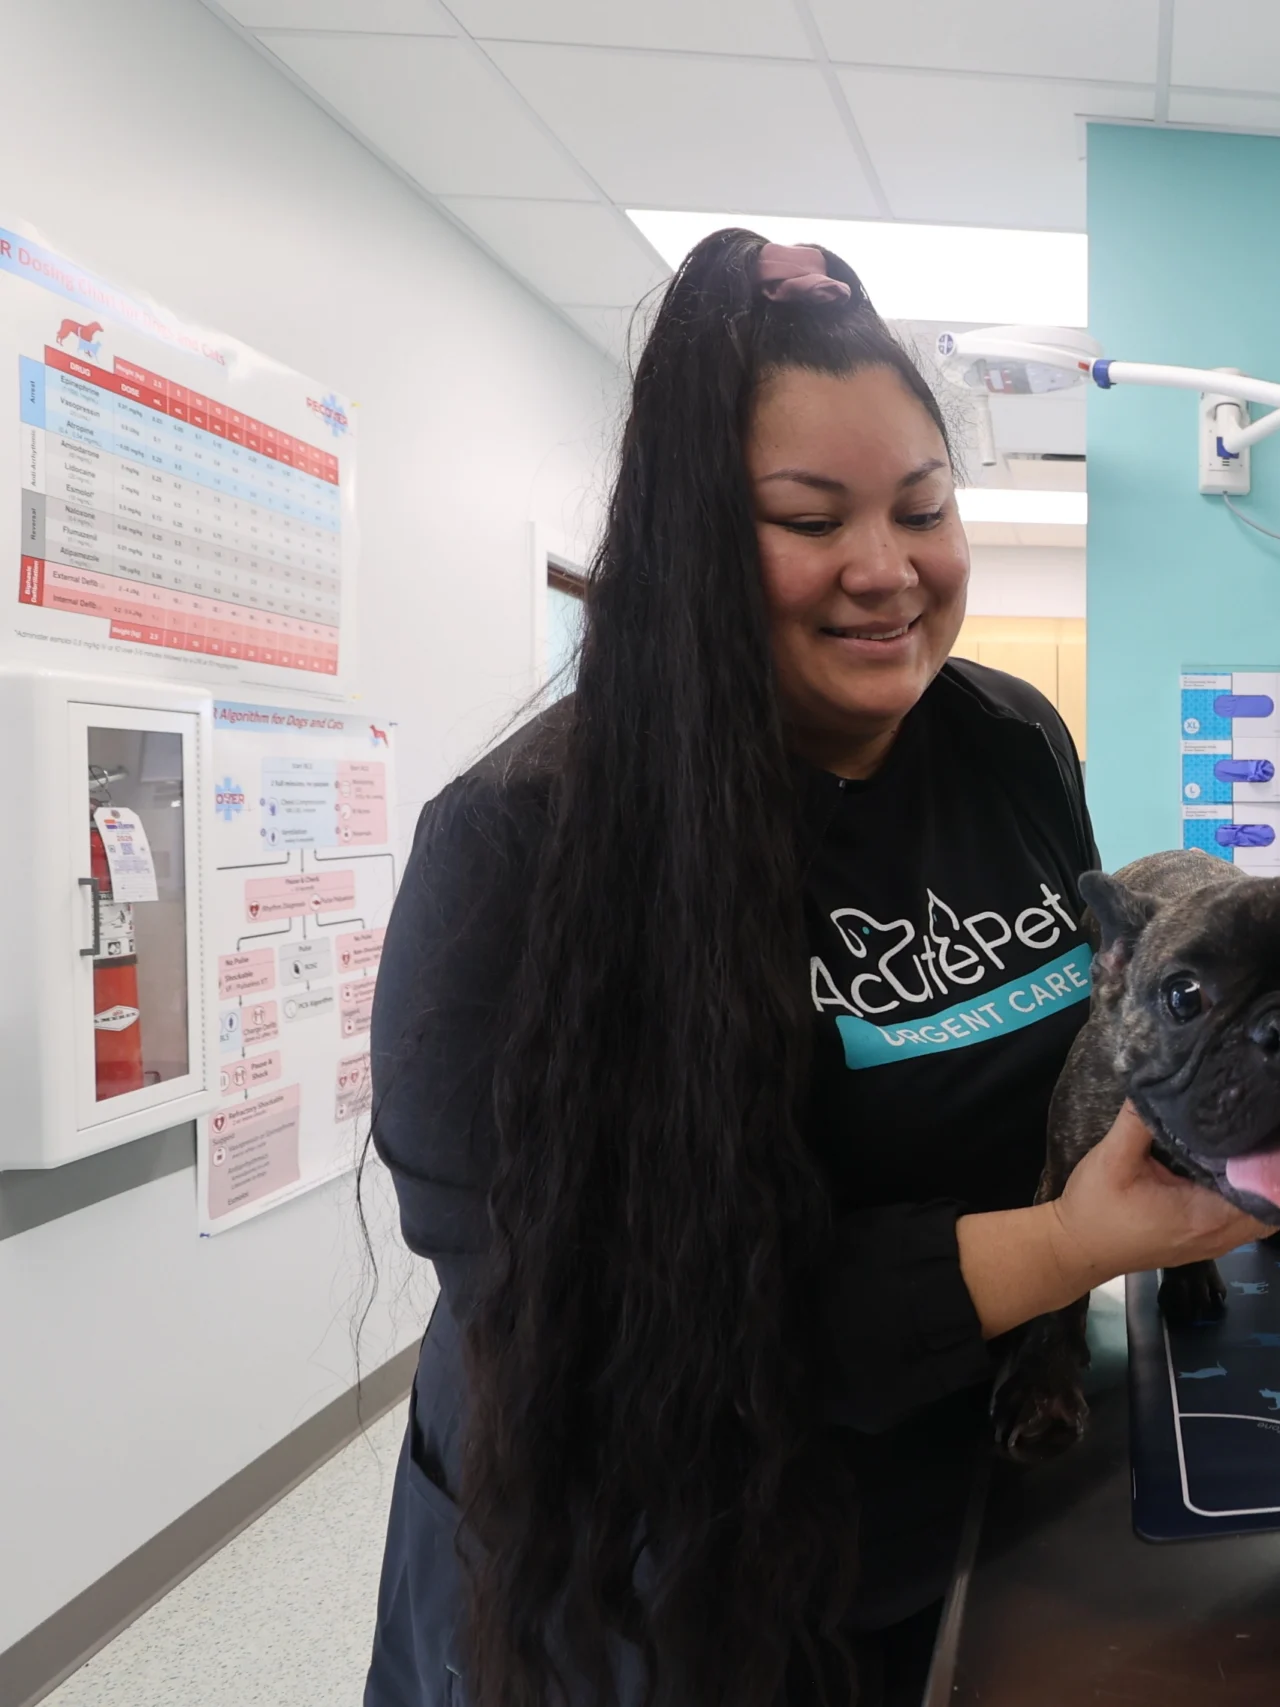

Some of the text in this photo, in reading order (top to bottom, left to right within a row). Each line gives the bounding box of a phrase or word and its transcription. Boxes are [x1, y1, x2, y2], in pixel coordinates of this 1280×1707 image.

[18, 247, 74, 292] Dosing
[60, 375, 100, 397] Epinephrine
[69, 361, 92, 377] DRUG
[120, 383, 140, 398] DOSE
[60, 396, 100, 417] Vasopressin
[66, 420, 94, 436] Atropine
[60, 440, 100, 459] Amiodarone
[64, 462, 96, 478] Lidocaine
[65, 505, 96, 520] Naloxone
[62, 525, 98, 541] Flumazenil
[60, 547, 100, 562] Atipamezole
[24, 565, 32, 595] Biphasic
[31, 559, 39, 603] Defibrillation
[52, 571, 99, 587] External Defib
[52, 594, 79, 605] Internal
[80, 599, 97, 609] Defib
[219, 707, 344, 730] Algorithm for Dogs and Cats
[1186, 721, 1198, 730] XL
[1190, 786, 1196, 795] L
[234, 957, 249, 965] Pulse
[224, 971, 254, 983] Shockable
[876, 963, 1088, 1048] URGENT CARE
[251, 1061, 267, 1071] Pause
[251, 1070, 268, 1081] Shock
[228, 1095, 284, 1119] Refractory Shockable
[212, 1132, 236, 1147] Suggest
